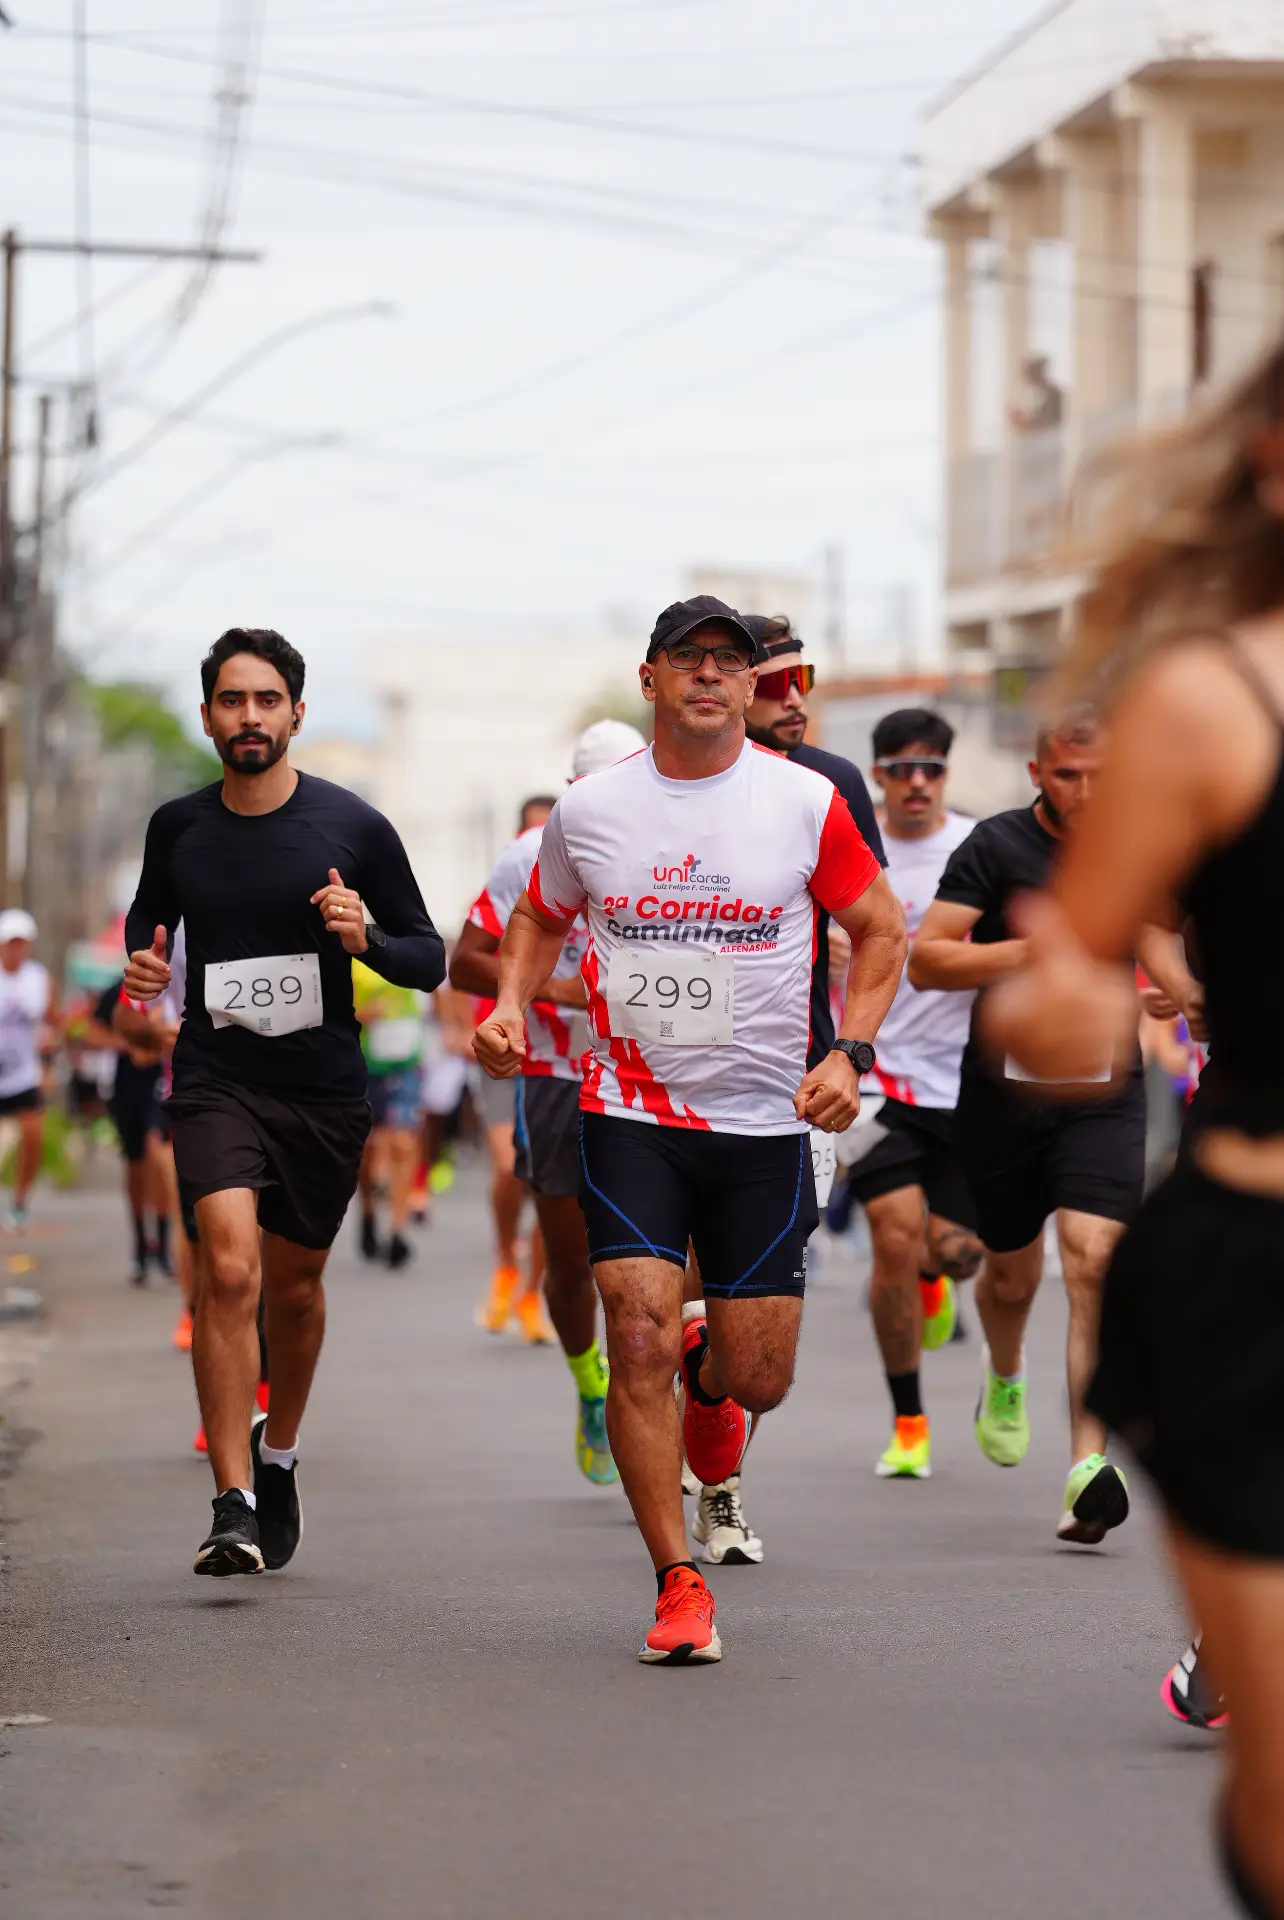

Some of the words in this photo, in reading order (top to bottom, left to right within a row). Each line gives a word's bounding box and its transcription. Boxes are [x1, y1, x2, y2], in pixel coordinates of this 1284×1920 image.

[668, 884, 691, 892] Felipe
[699, 885, 731, 893] Cruvinel
[635, 894, 764, 923] Corrida
[768, 905, 784, 921] e
[607, 918, 781, 944] Caminhada
[719, 941, 778, 954] ALFENAS/MG
[223, 975, 303, 1011] 289
[625, 973, 712, 1011] 299
